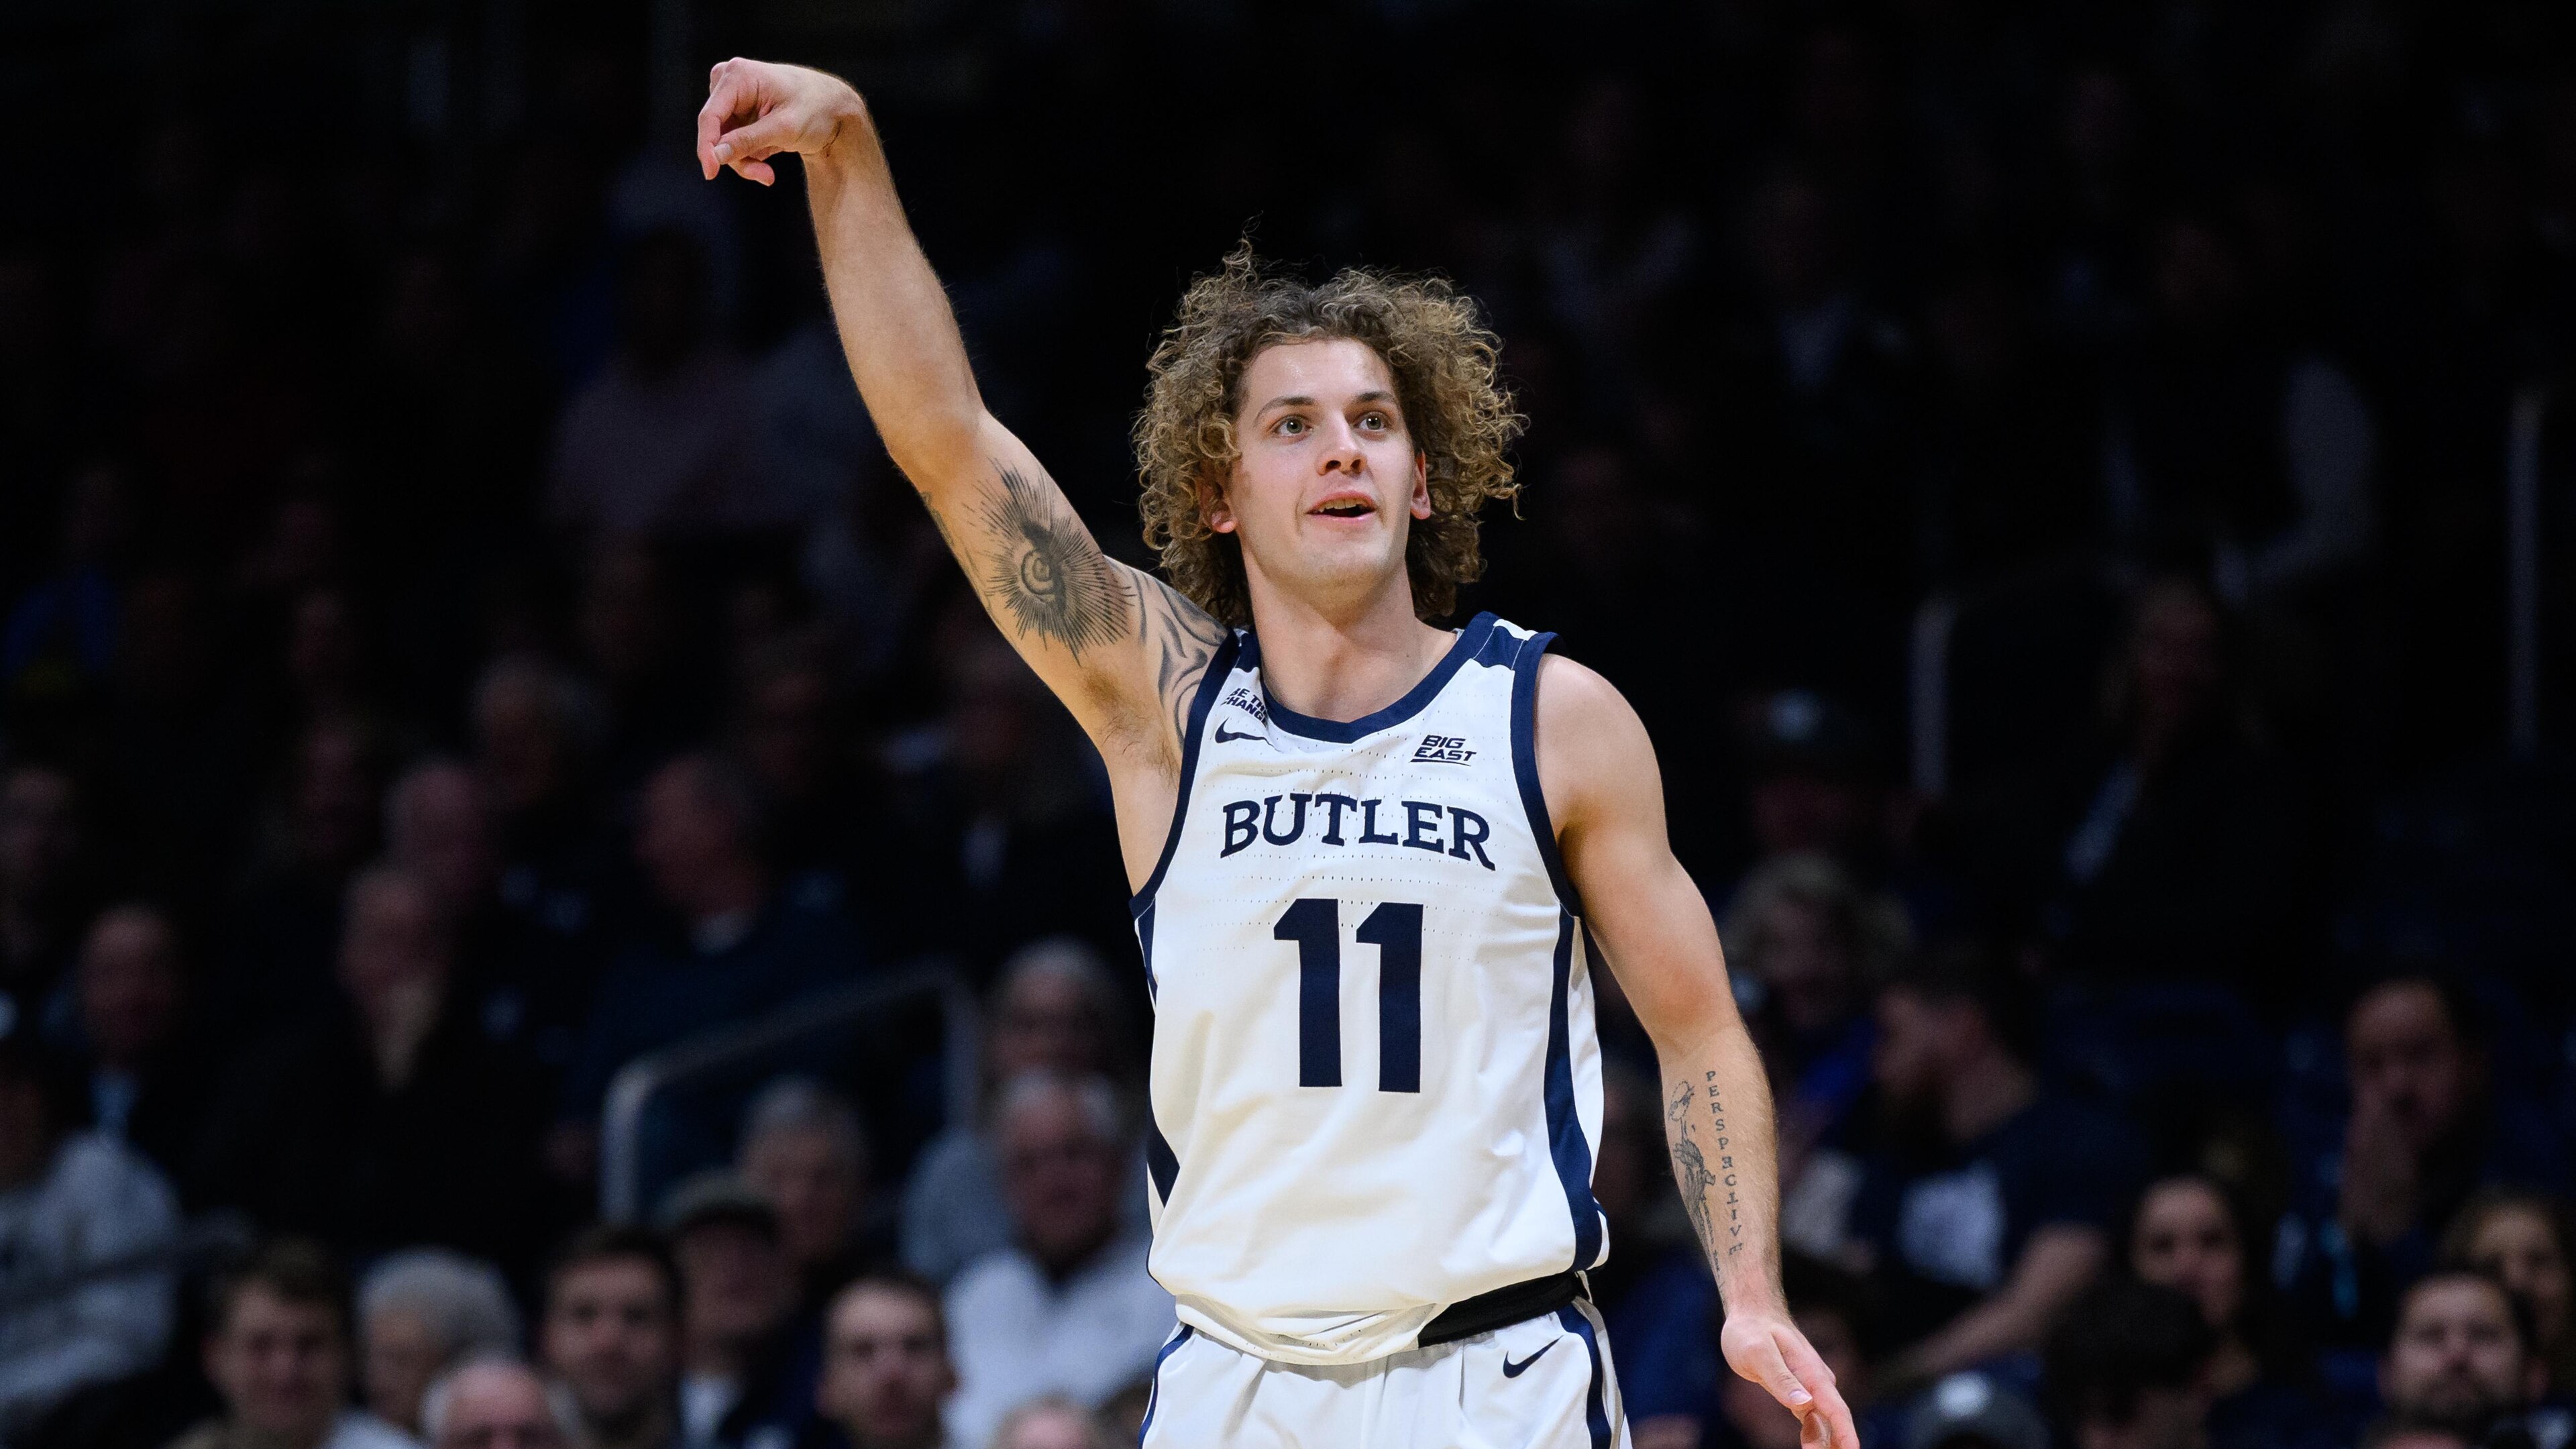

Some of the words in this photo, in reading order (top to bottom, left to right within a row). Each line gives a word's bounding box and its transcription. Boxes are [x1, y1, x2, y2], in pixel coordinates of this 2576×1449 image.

[1229, 688, 1250, 698] BE
[1421, 735, 1466, 749] BIG
[1413, 747, 1477, 761] EAST
[1220, 792, 1496, 871] BUTLER
[1273, 898, 1424, 1093] 11
